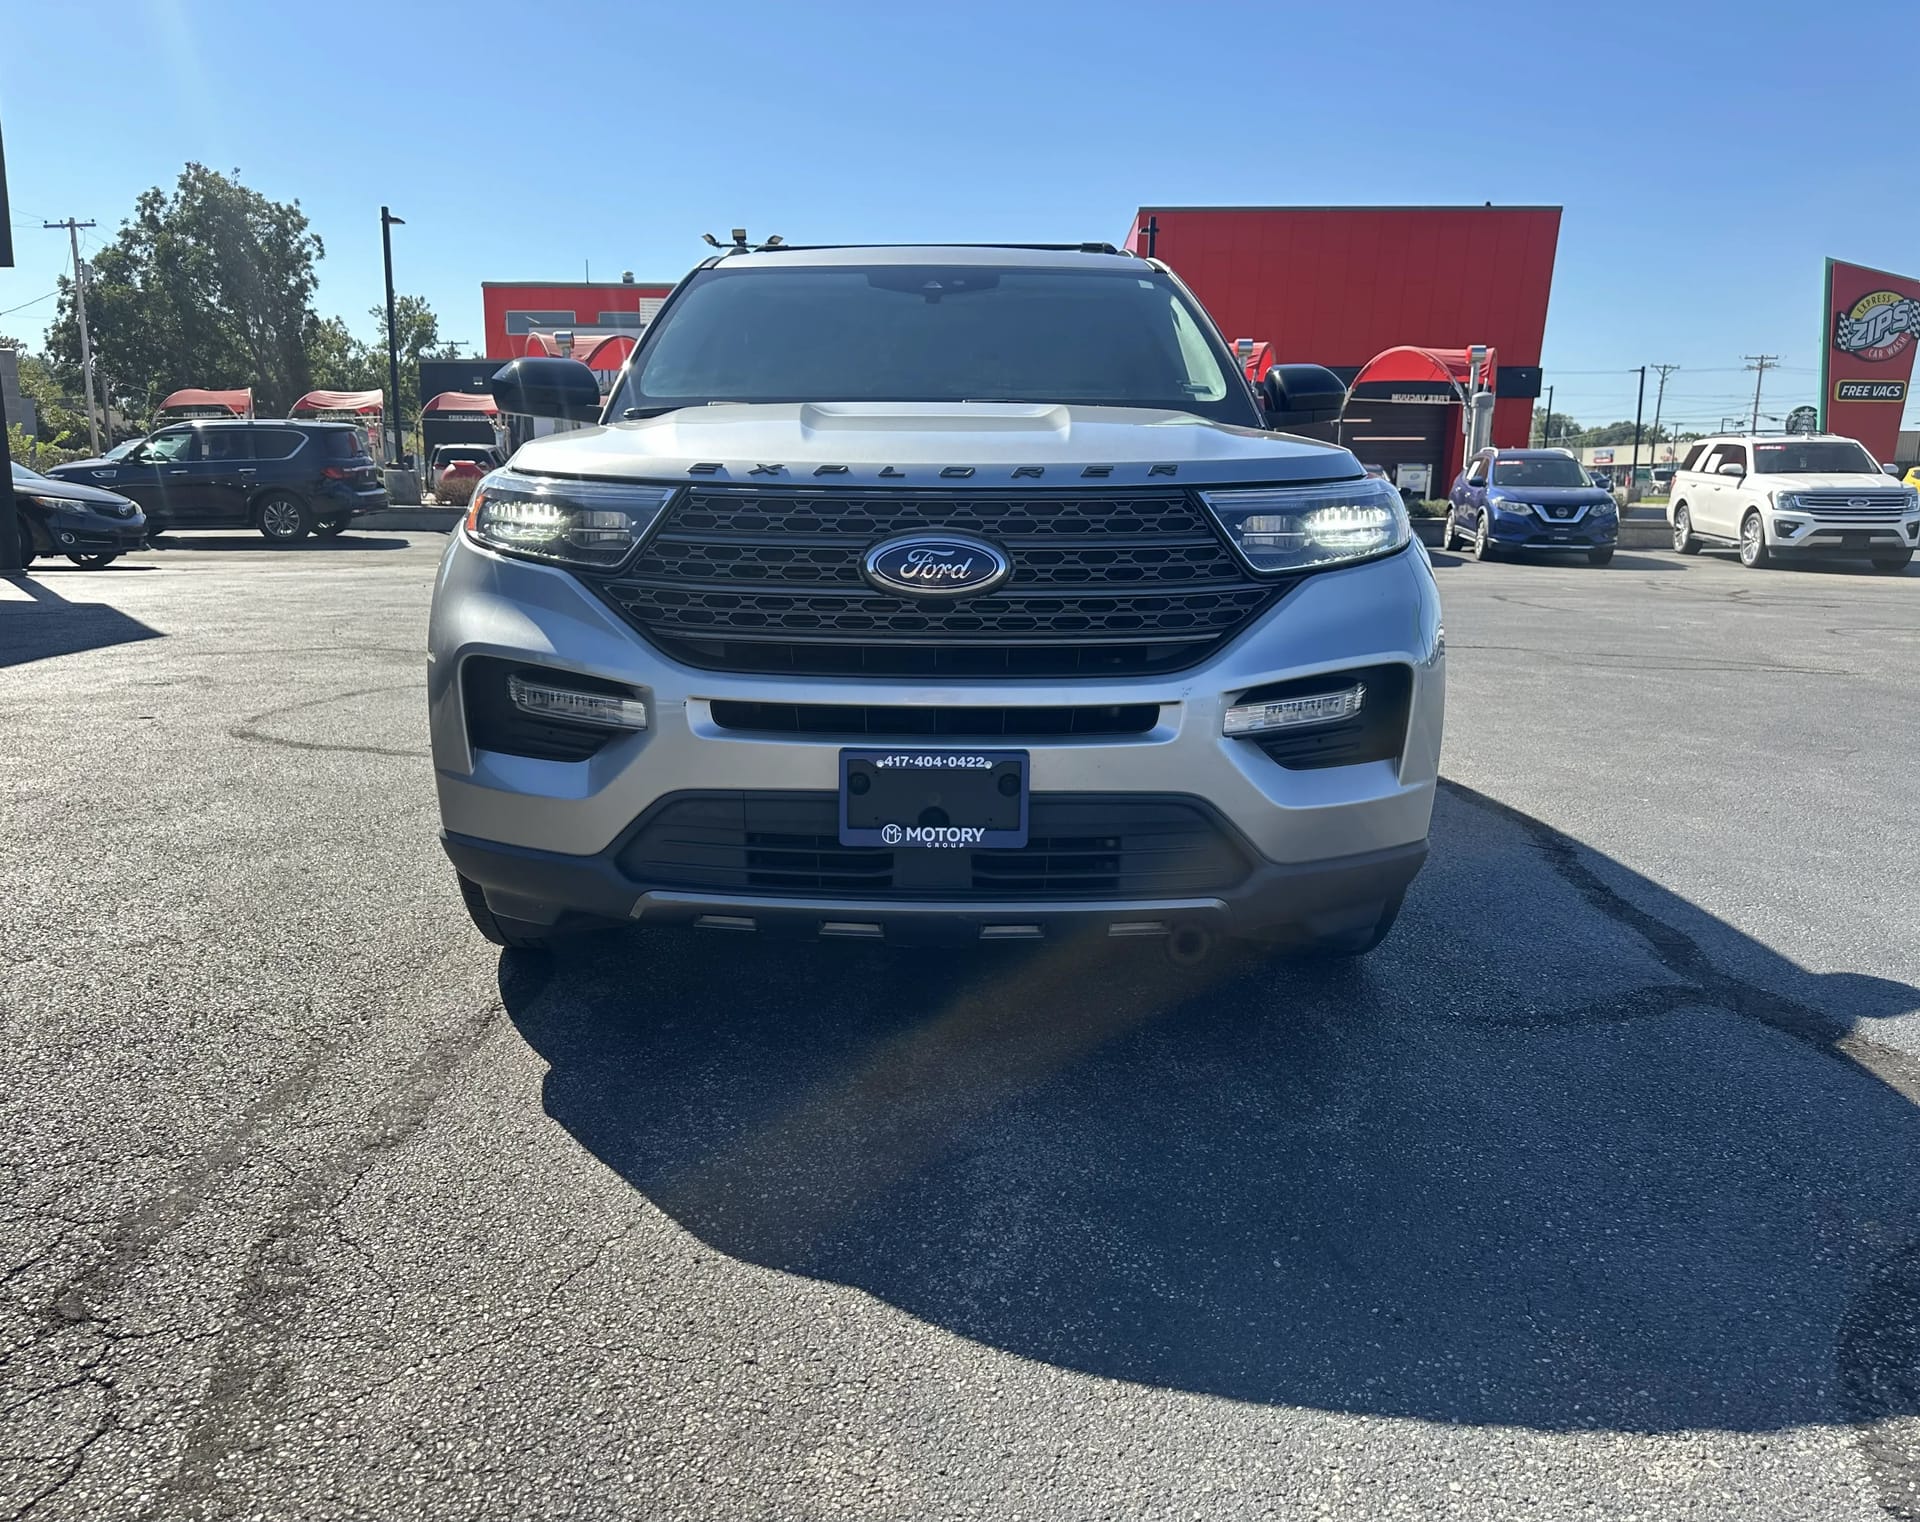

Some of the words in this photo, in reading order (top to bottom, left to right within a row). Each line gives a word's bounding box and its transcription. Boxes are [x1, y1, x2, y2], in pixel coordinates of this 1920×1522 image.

[1857, 294, 1891, 314] EXPRESS
[1849, 304, 1909, 347] ZIPS
[1868, 349, 1883, 358] CAR
[1886, 337, 1908, 356] WASH
[1841, 385, 1871, 397] FREE
[1872, 385, 1902, 397] VACS
[687, 462, 1179, 478] EXPLORER
[900, 548, 974, 579] Ford
[906, 827, 985, 842] MOTORY
